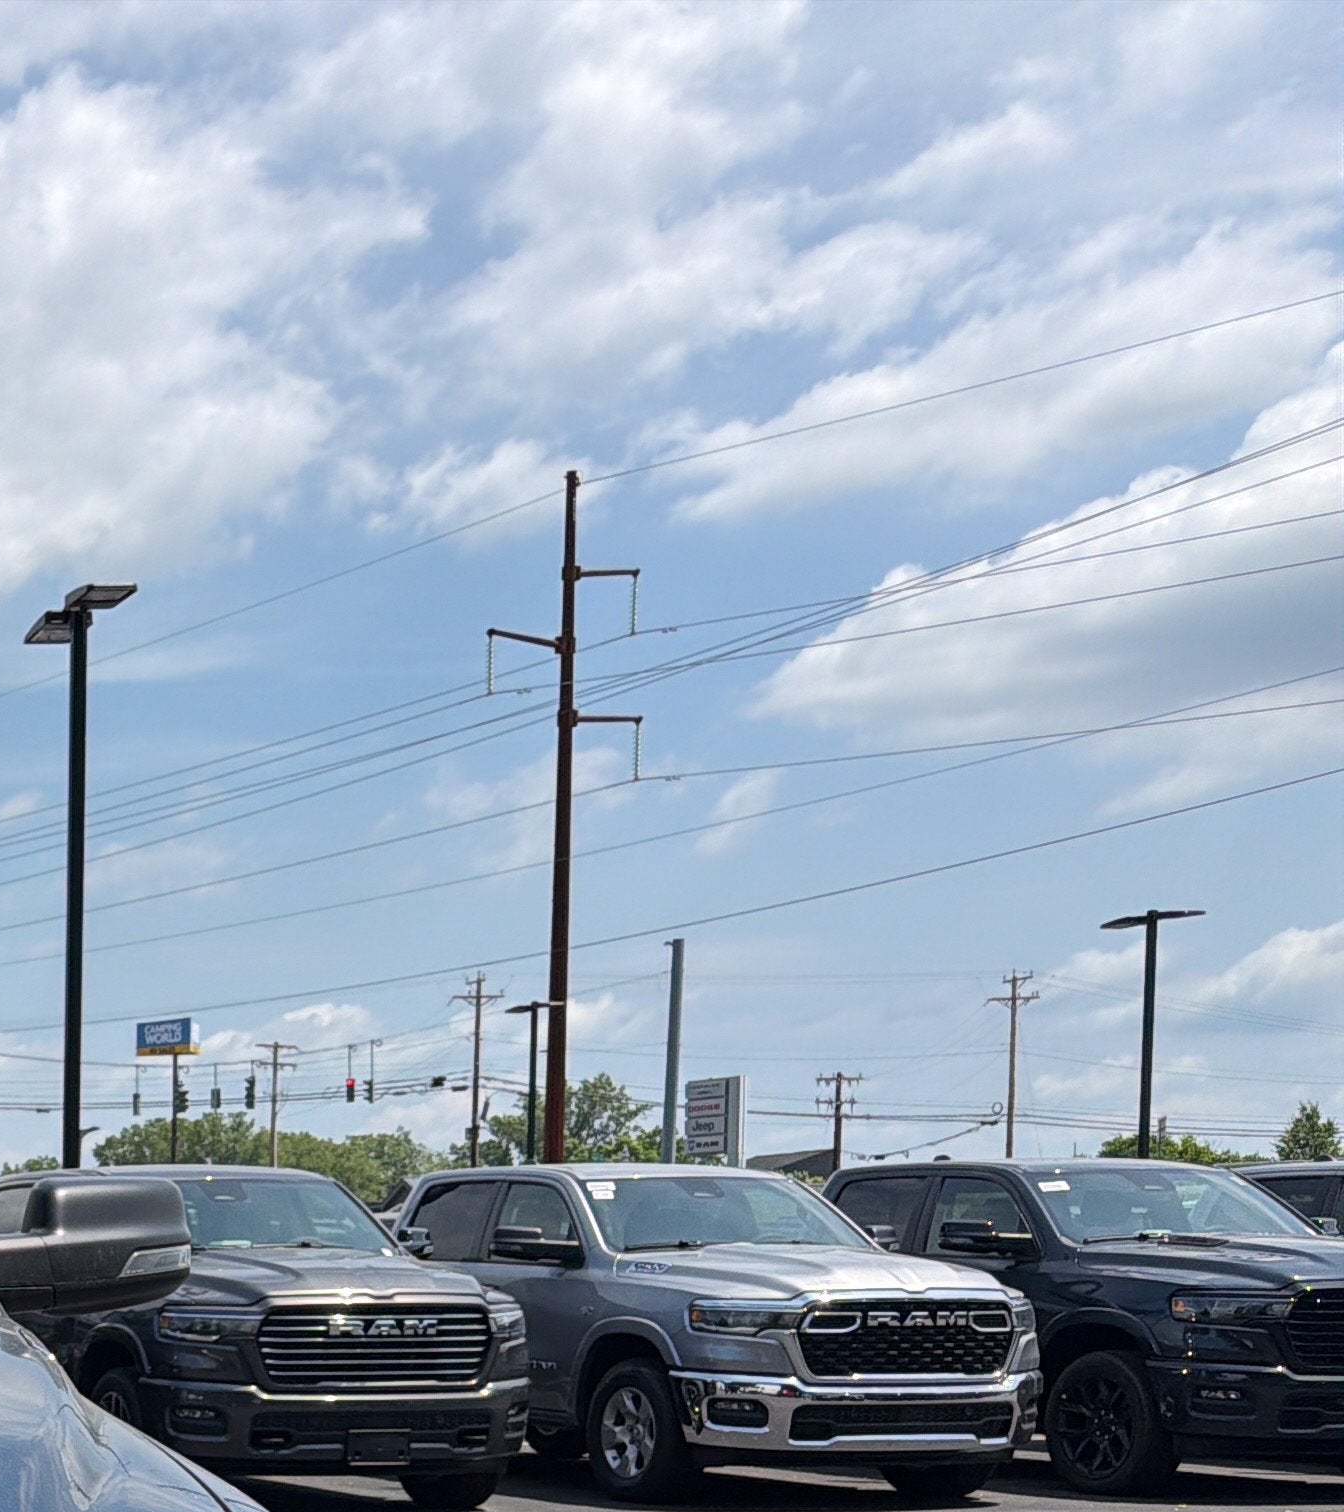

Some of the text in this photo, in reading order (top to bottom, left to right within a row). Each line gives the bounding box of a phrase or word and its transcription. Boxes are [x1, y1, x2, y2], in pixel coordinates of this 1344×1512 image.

[144, 1022, 183, 1035] CAMPING
[144, 1031, 182, 1045] WORLD
[688, 1103, 721, 1113] DODGE
[692, 1120, 715, 1133] Jeep
[696, 1140, 719, 1149] RAM
[866, 1311, 968, 1327] RAM
[328, 1319, 439, 1336] RAM
